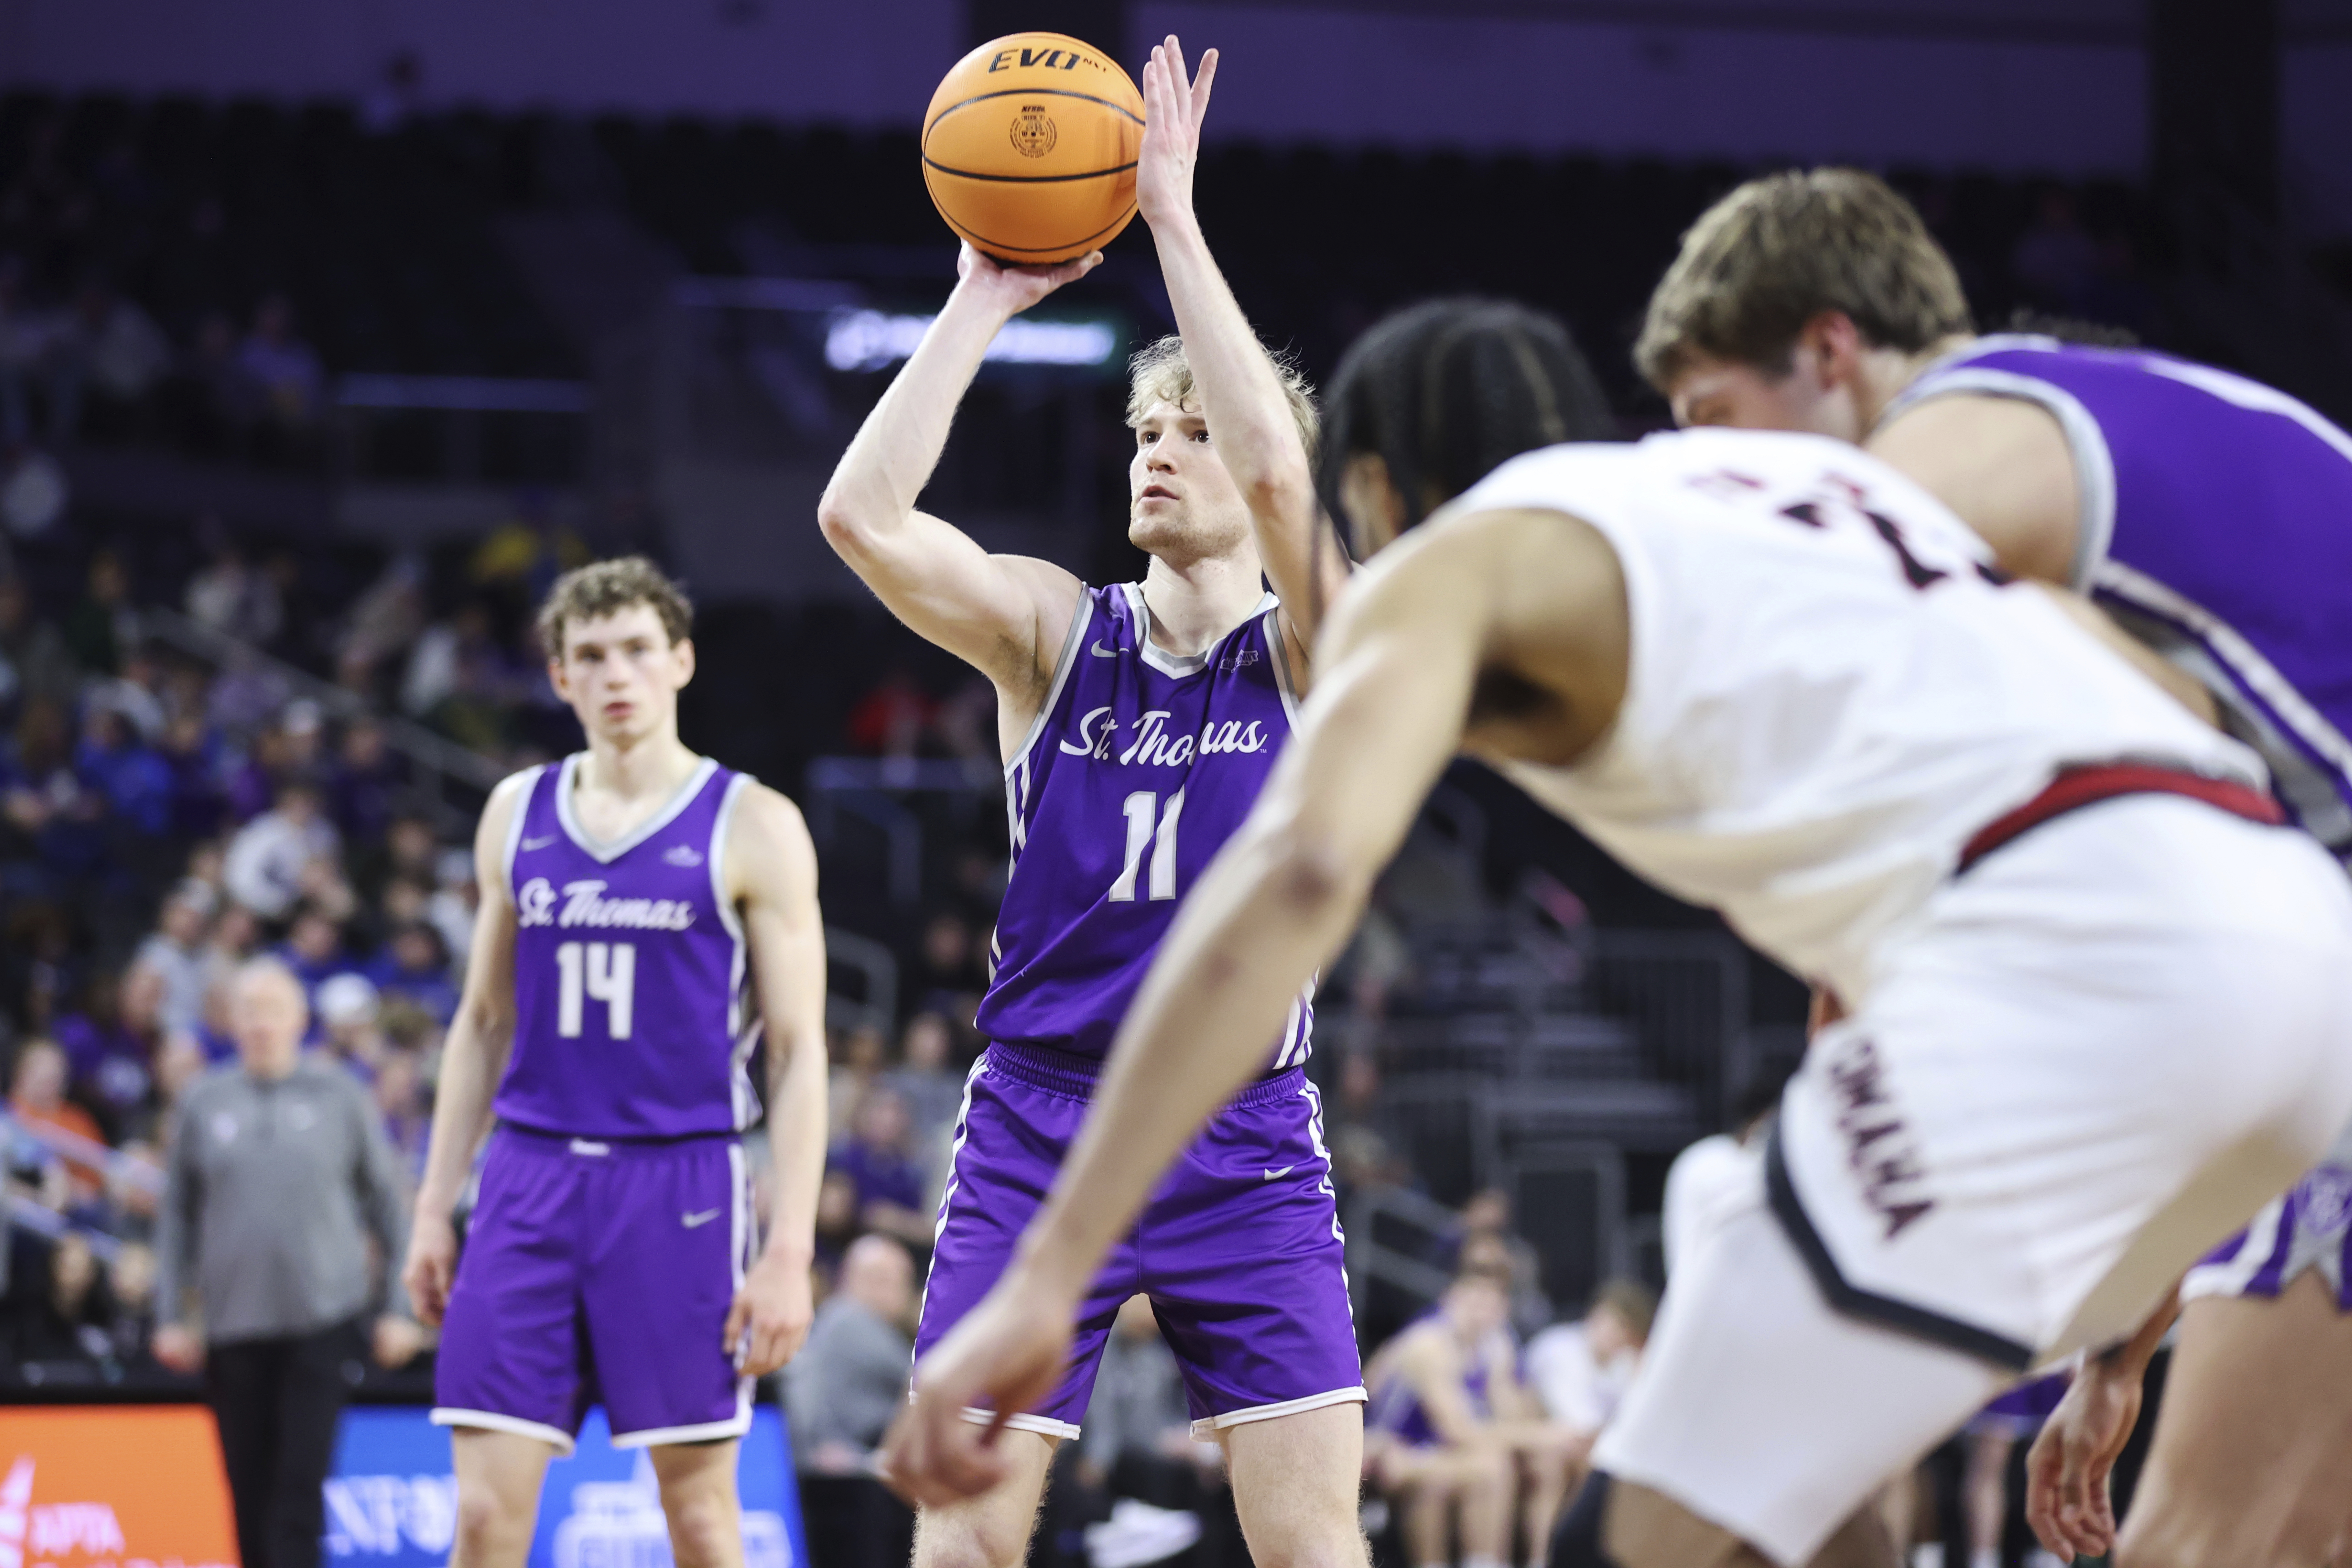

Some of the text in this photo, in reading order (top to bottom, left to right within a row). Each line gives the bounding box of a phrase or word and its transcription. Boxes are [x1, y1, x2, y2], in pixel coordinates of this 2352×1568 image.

[987, 48, 1080, 74] EVO
[1060, 706, 1118, 760] St.
[1108, 783, 1185, 902] 11
[558, 879, 697, 931] Thomas
[555, 941, 636, 1041] 14
